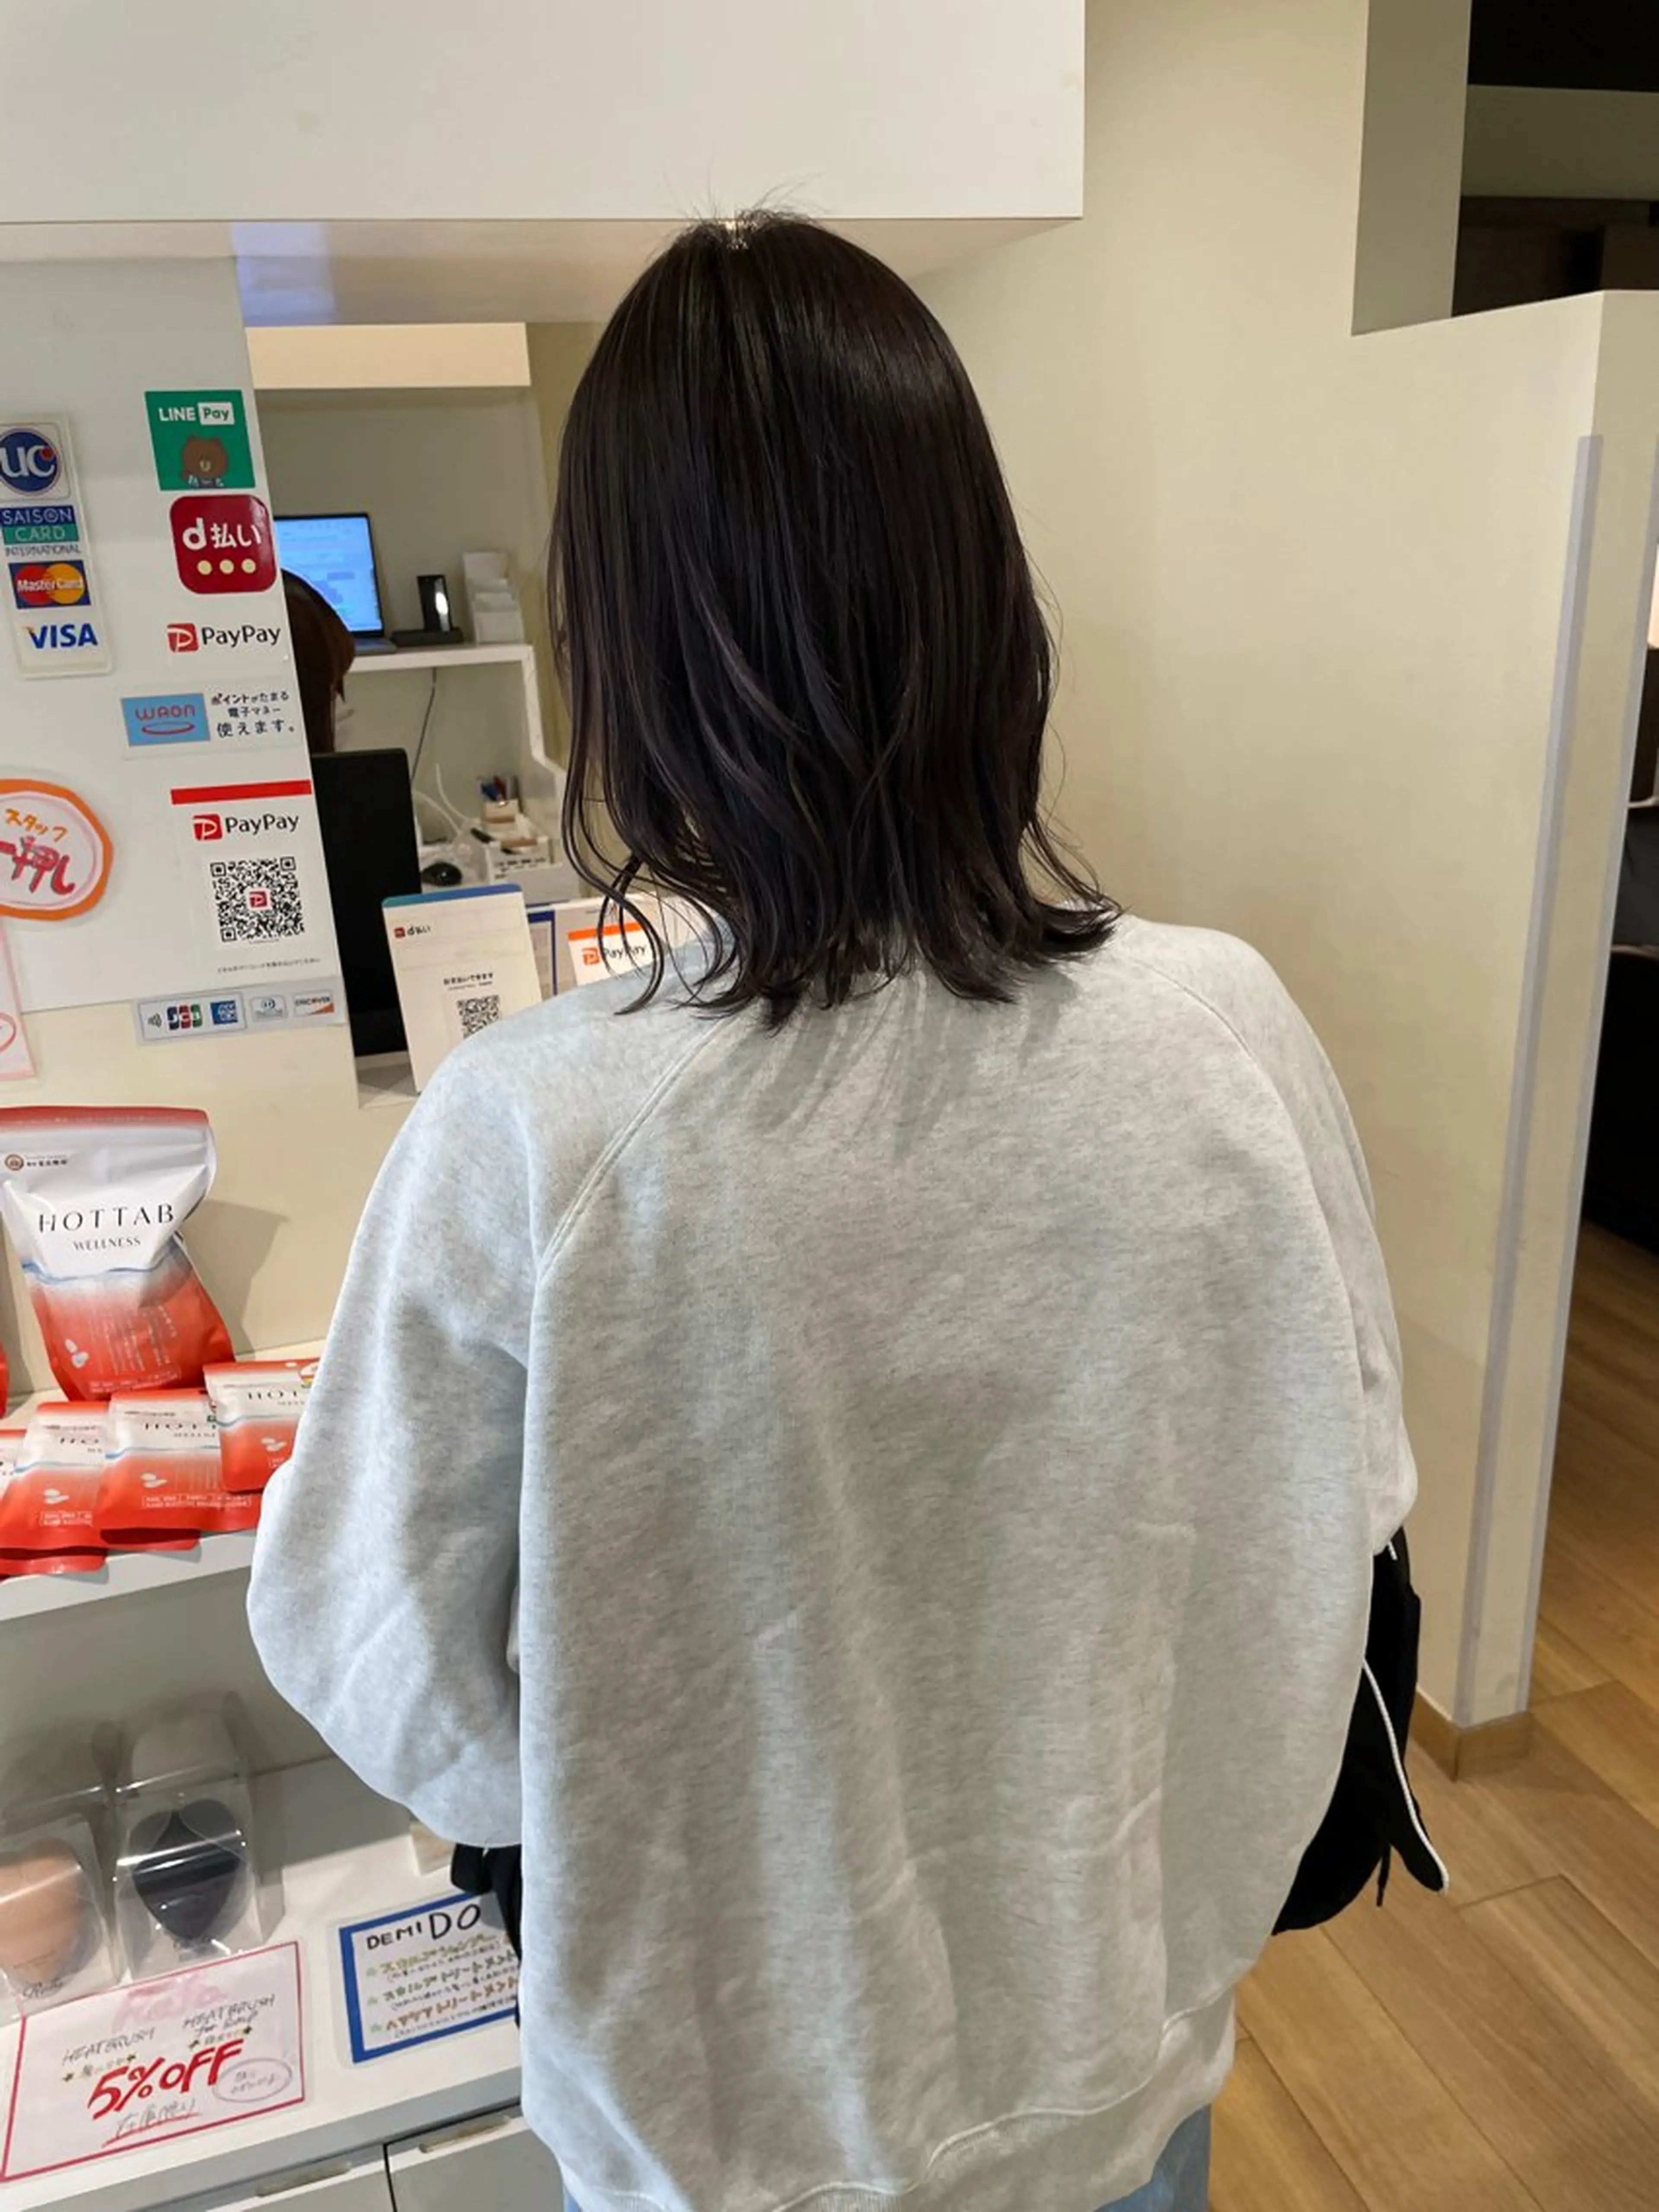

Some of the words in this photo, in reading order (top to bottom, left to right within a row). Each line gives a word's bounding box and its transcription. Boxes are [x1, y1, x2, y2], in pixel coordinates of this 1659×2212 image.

[158, 407, 196, 421] LINE
[203, 407, 229, 420] Pay
[2, 508, 72, 525] SAISON
[15, 525, 65, 542] CARD
[182, 517, 261, 550] d払い
[27, 623, 99, 648] VISA
[201, 625, 281, 647] PayPay
[5, 807, 68, 842] スタッフ
[225, 813, 299, 835] PayPay
[72, 1236, 141, 1251] WELLNESS
